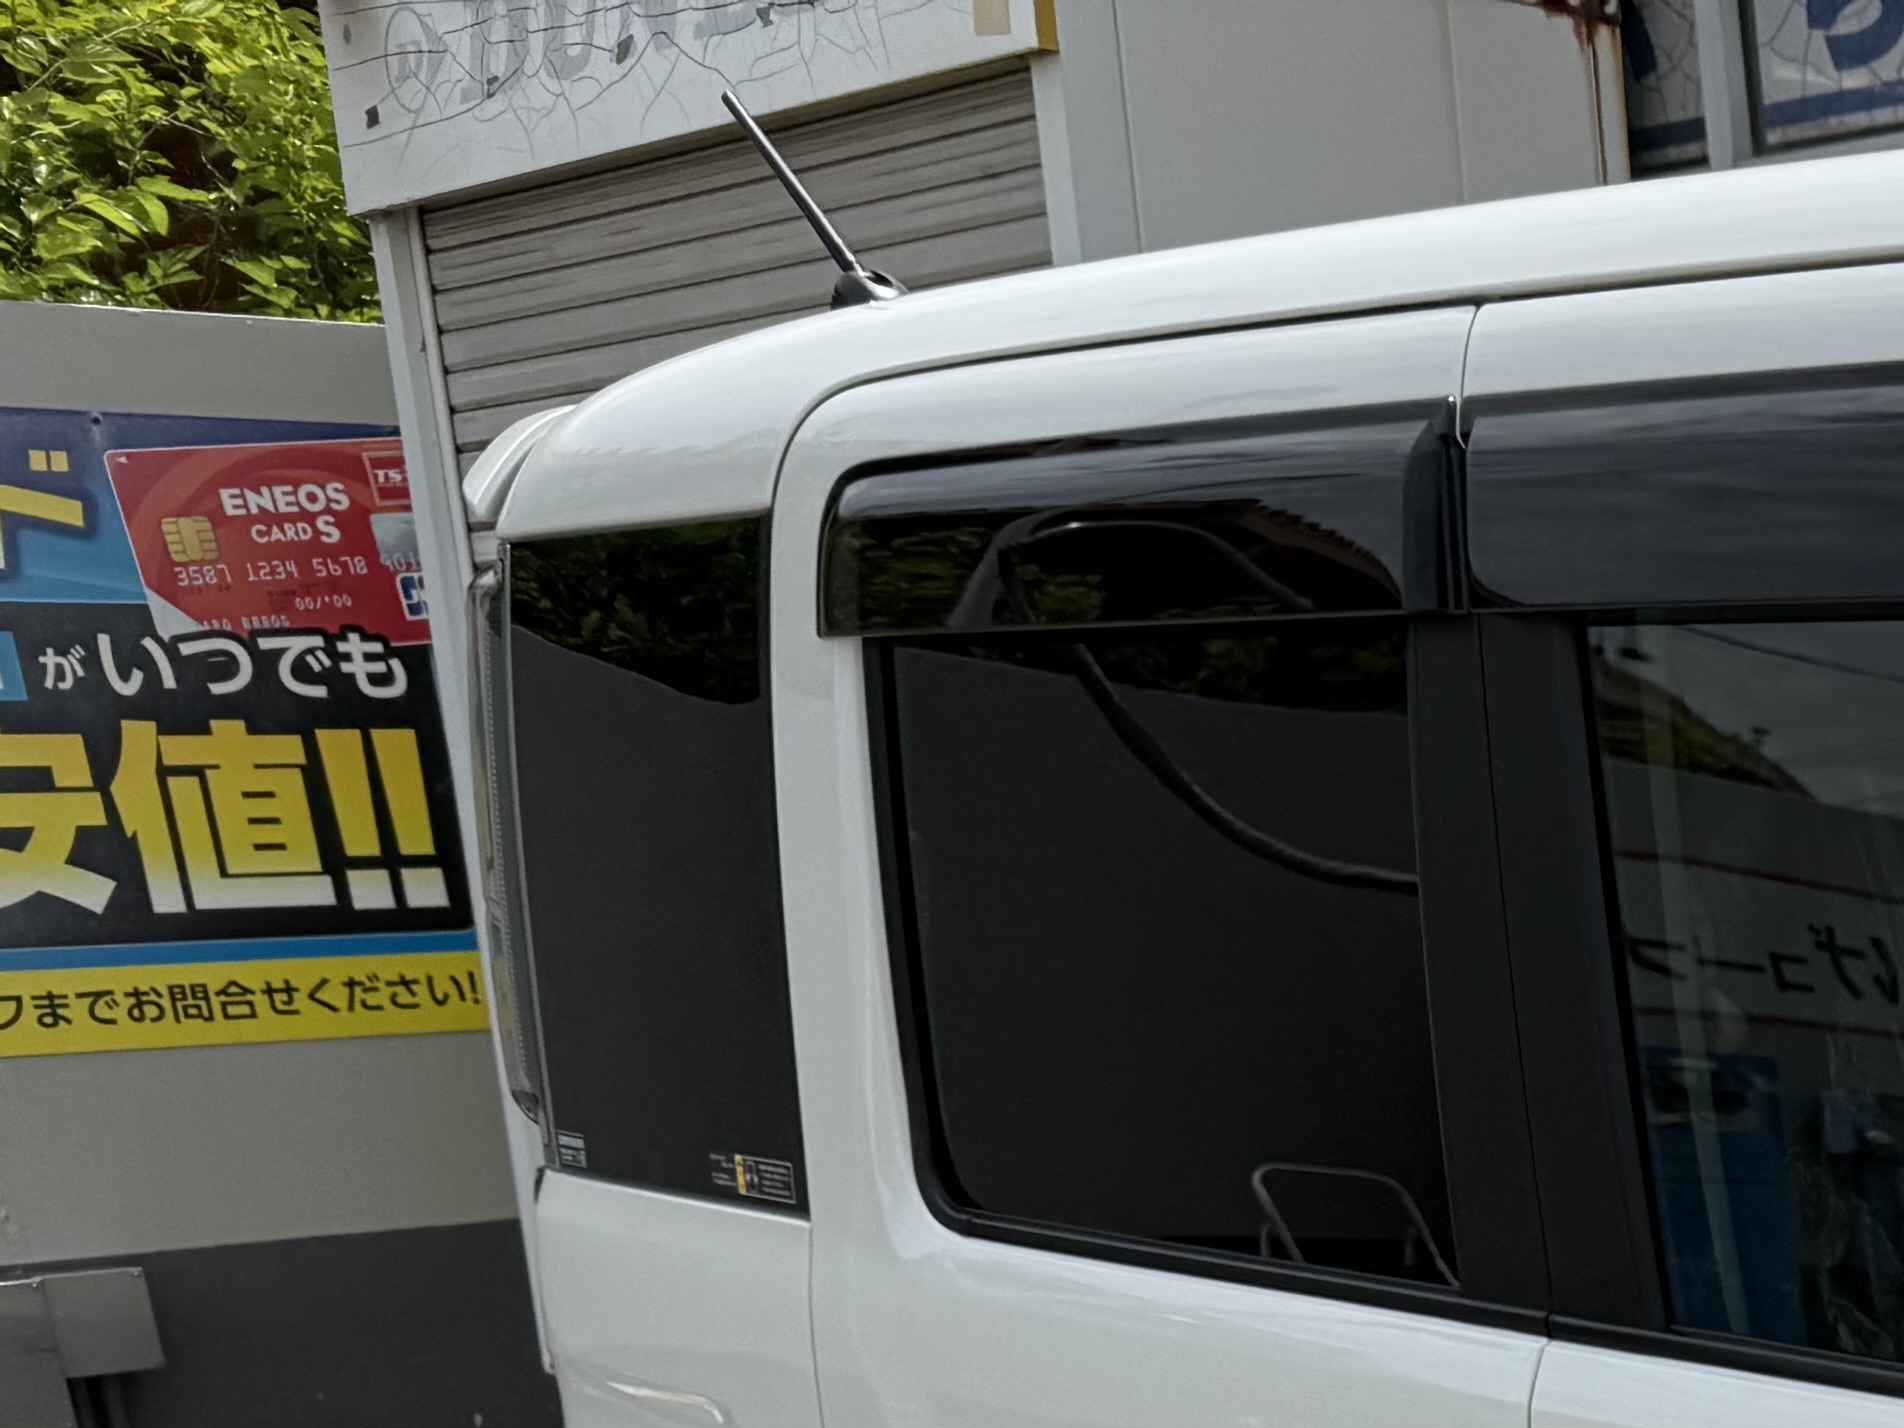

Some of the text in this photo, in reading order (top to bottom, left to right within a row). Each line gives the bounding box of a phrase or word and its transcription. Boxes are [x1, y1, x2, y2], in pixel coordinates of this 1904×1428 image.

[218, 481, 351, 517] ENEOS
[250, 515, 342, 544] CARD S
[173, 564, 233, 587] 3587
[246, 561, 300, 583] 1234
[310, 555, 368, 578] 5678
[382, 552, 422, 574] 901
[38, 629, 409, 700] がいつでも
